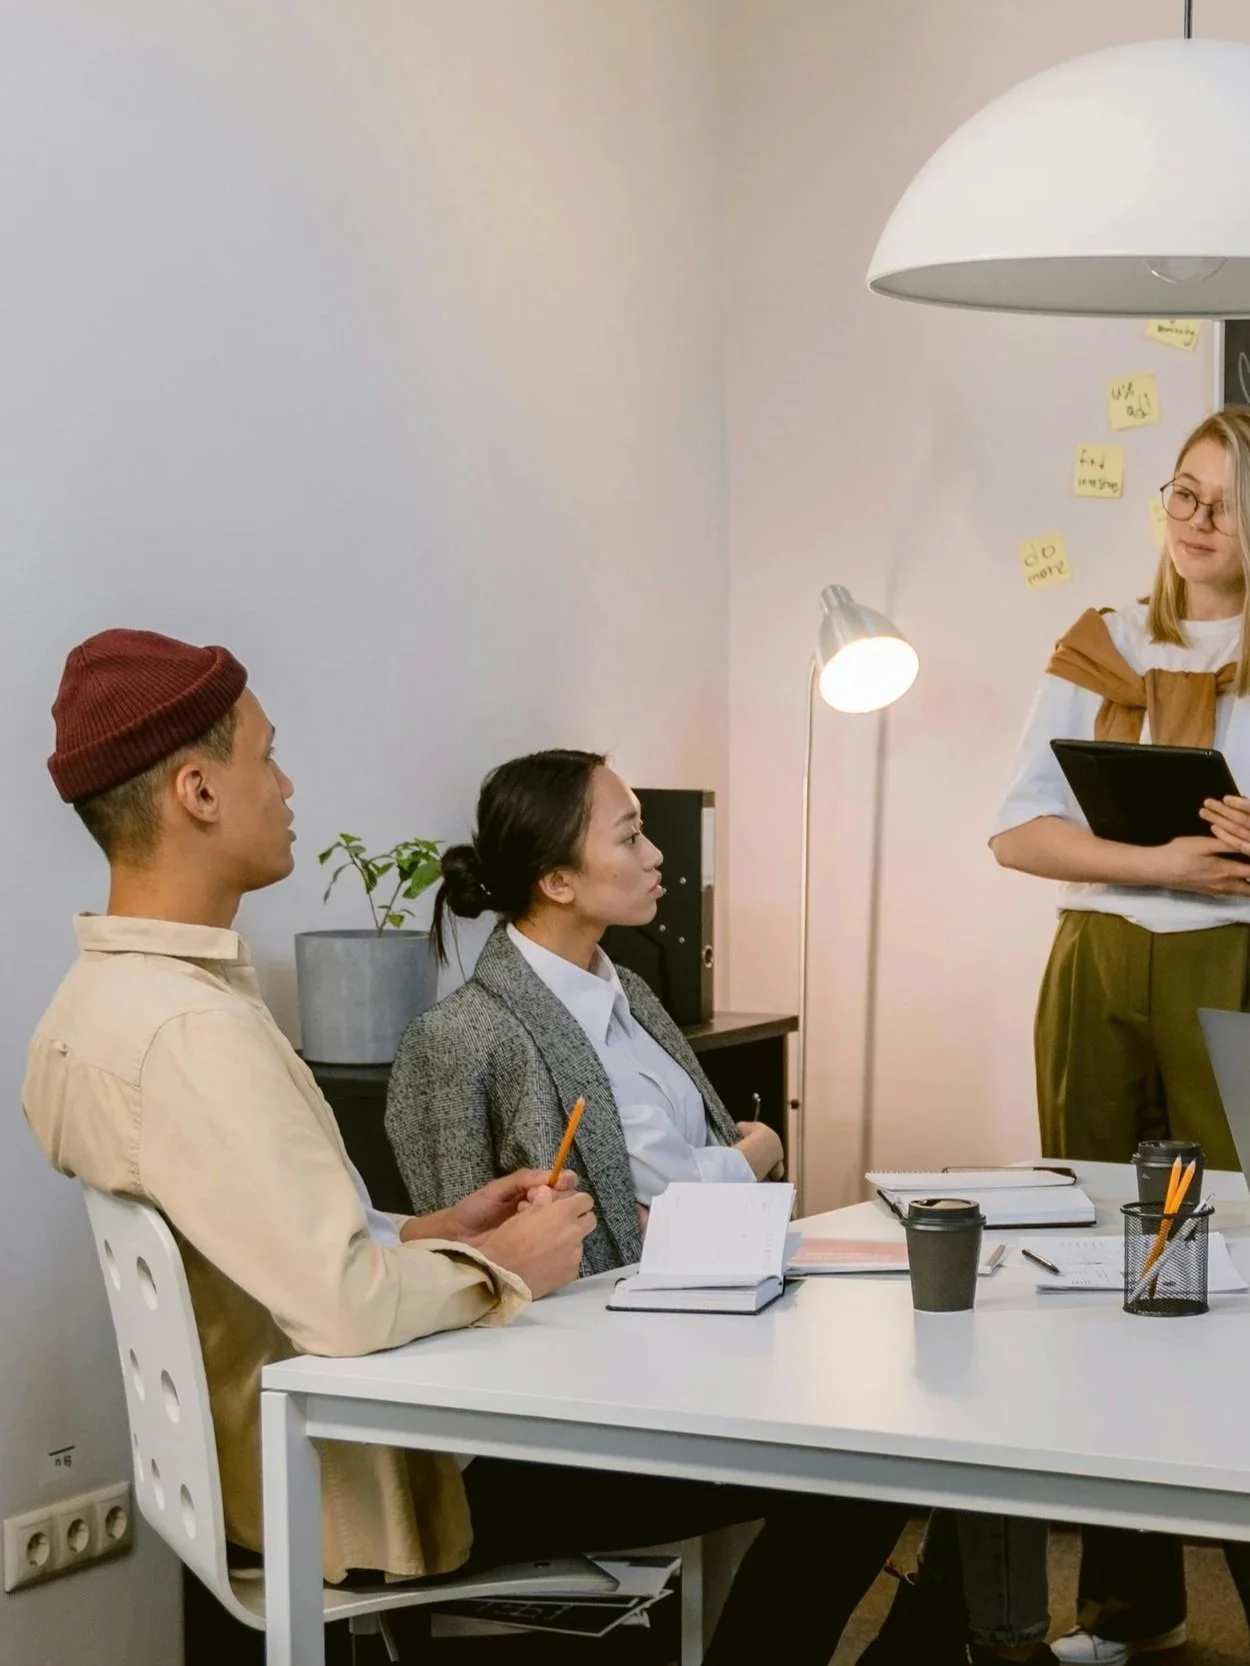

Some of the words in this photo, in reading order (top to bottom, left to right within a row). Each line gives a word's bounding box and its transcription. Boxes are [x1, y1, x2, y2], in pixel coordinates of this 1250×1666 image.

[1079, 448, 1105, 469] find
[1024, 543, 1056, 567] do
[1028, 560, 1068, 585] more
